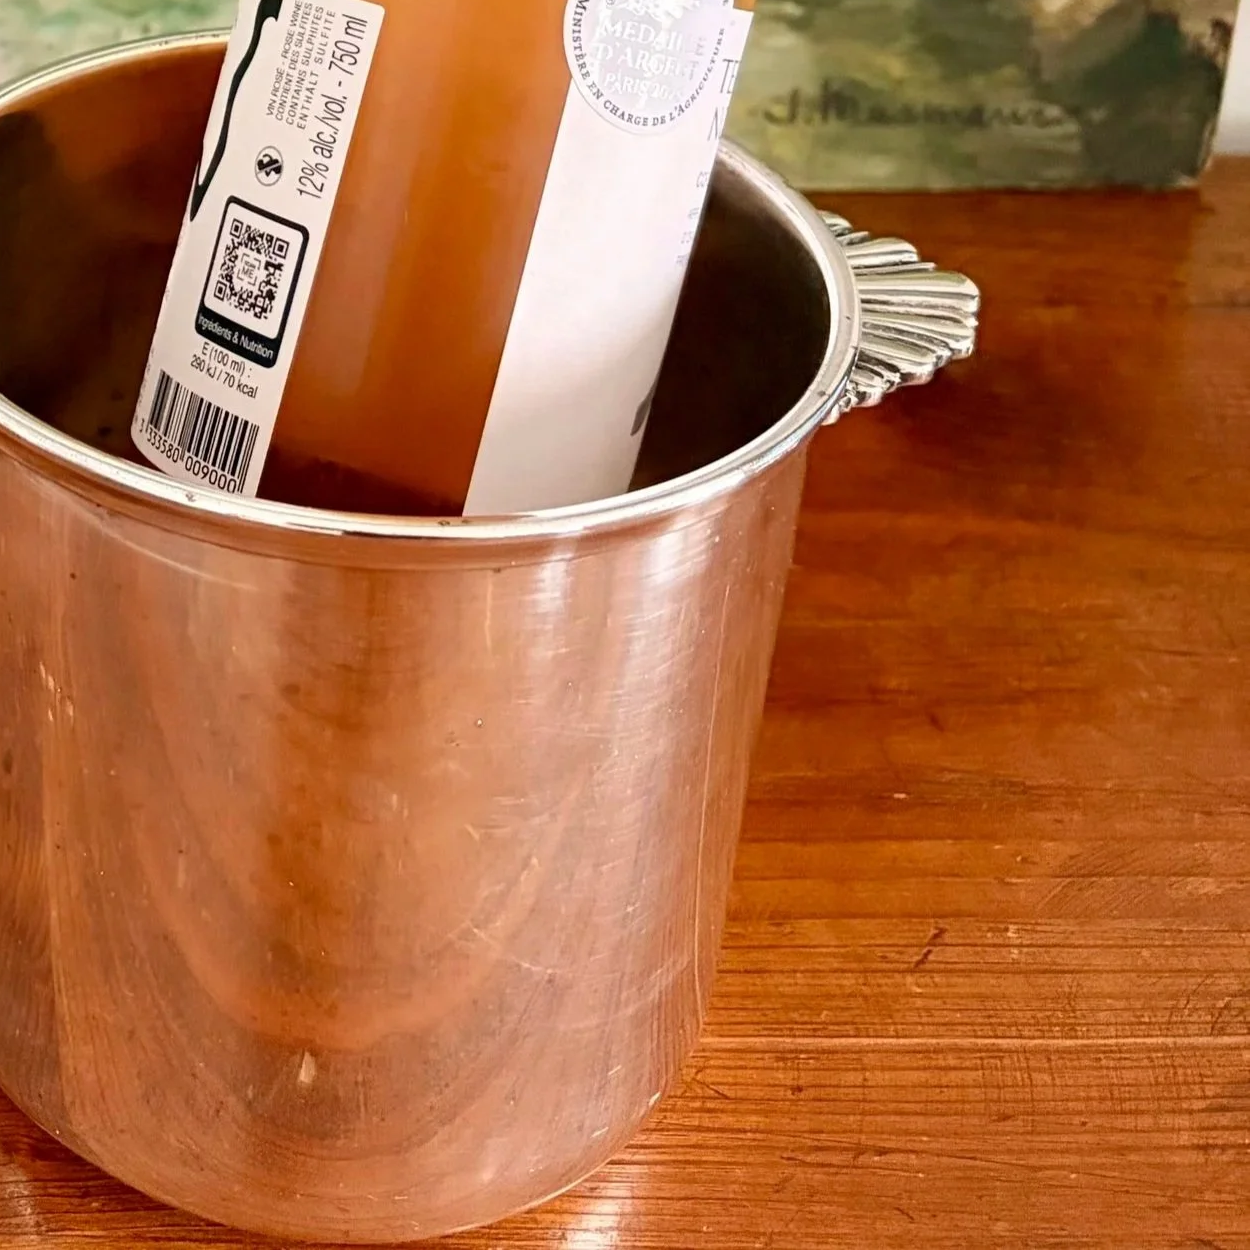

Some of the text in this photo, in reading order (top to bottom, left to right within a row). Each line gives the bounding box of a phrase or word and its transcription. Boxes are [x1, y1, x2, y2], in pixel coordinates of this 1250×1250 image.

[314, 10, 336, 65] SULFITE
[342, 14, 368, 40] ml
[266, 98, 277, 116] VIN
[289, 0, 303, 27] WINE
[272, 3, 313, 121] CONTIENT DES SULFITES
[285, 6, 324, 125] CONTAINS SULPHITES
[328, 40, 360, 75] 750
[587, 81, 604, 100] EN
[603, 100, 649, 127] CHARGE
[652, 116, 666, 127] DE
[669, 27, 725, 121] L'AGRICULTURE
[309, 94, 347, 159] alc./vol.
[296, 160, 329, 199] 12%
[202, 341, 210, 356] E
[209, 347, 229, 367] (100
[230, 360, 245, 377] ml)
[232, 332, 239, 344] &
[240, 335, 273, 359] Nutrition
[223, 371, 235, 388] 70
[236, 379, 258, 399] kcal
[146, 427, 183, 463] 333580
[185, 455, 240, 494] 009000
